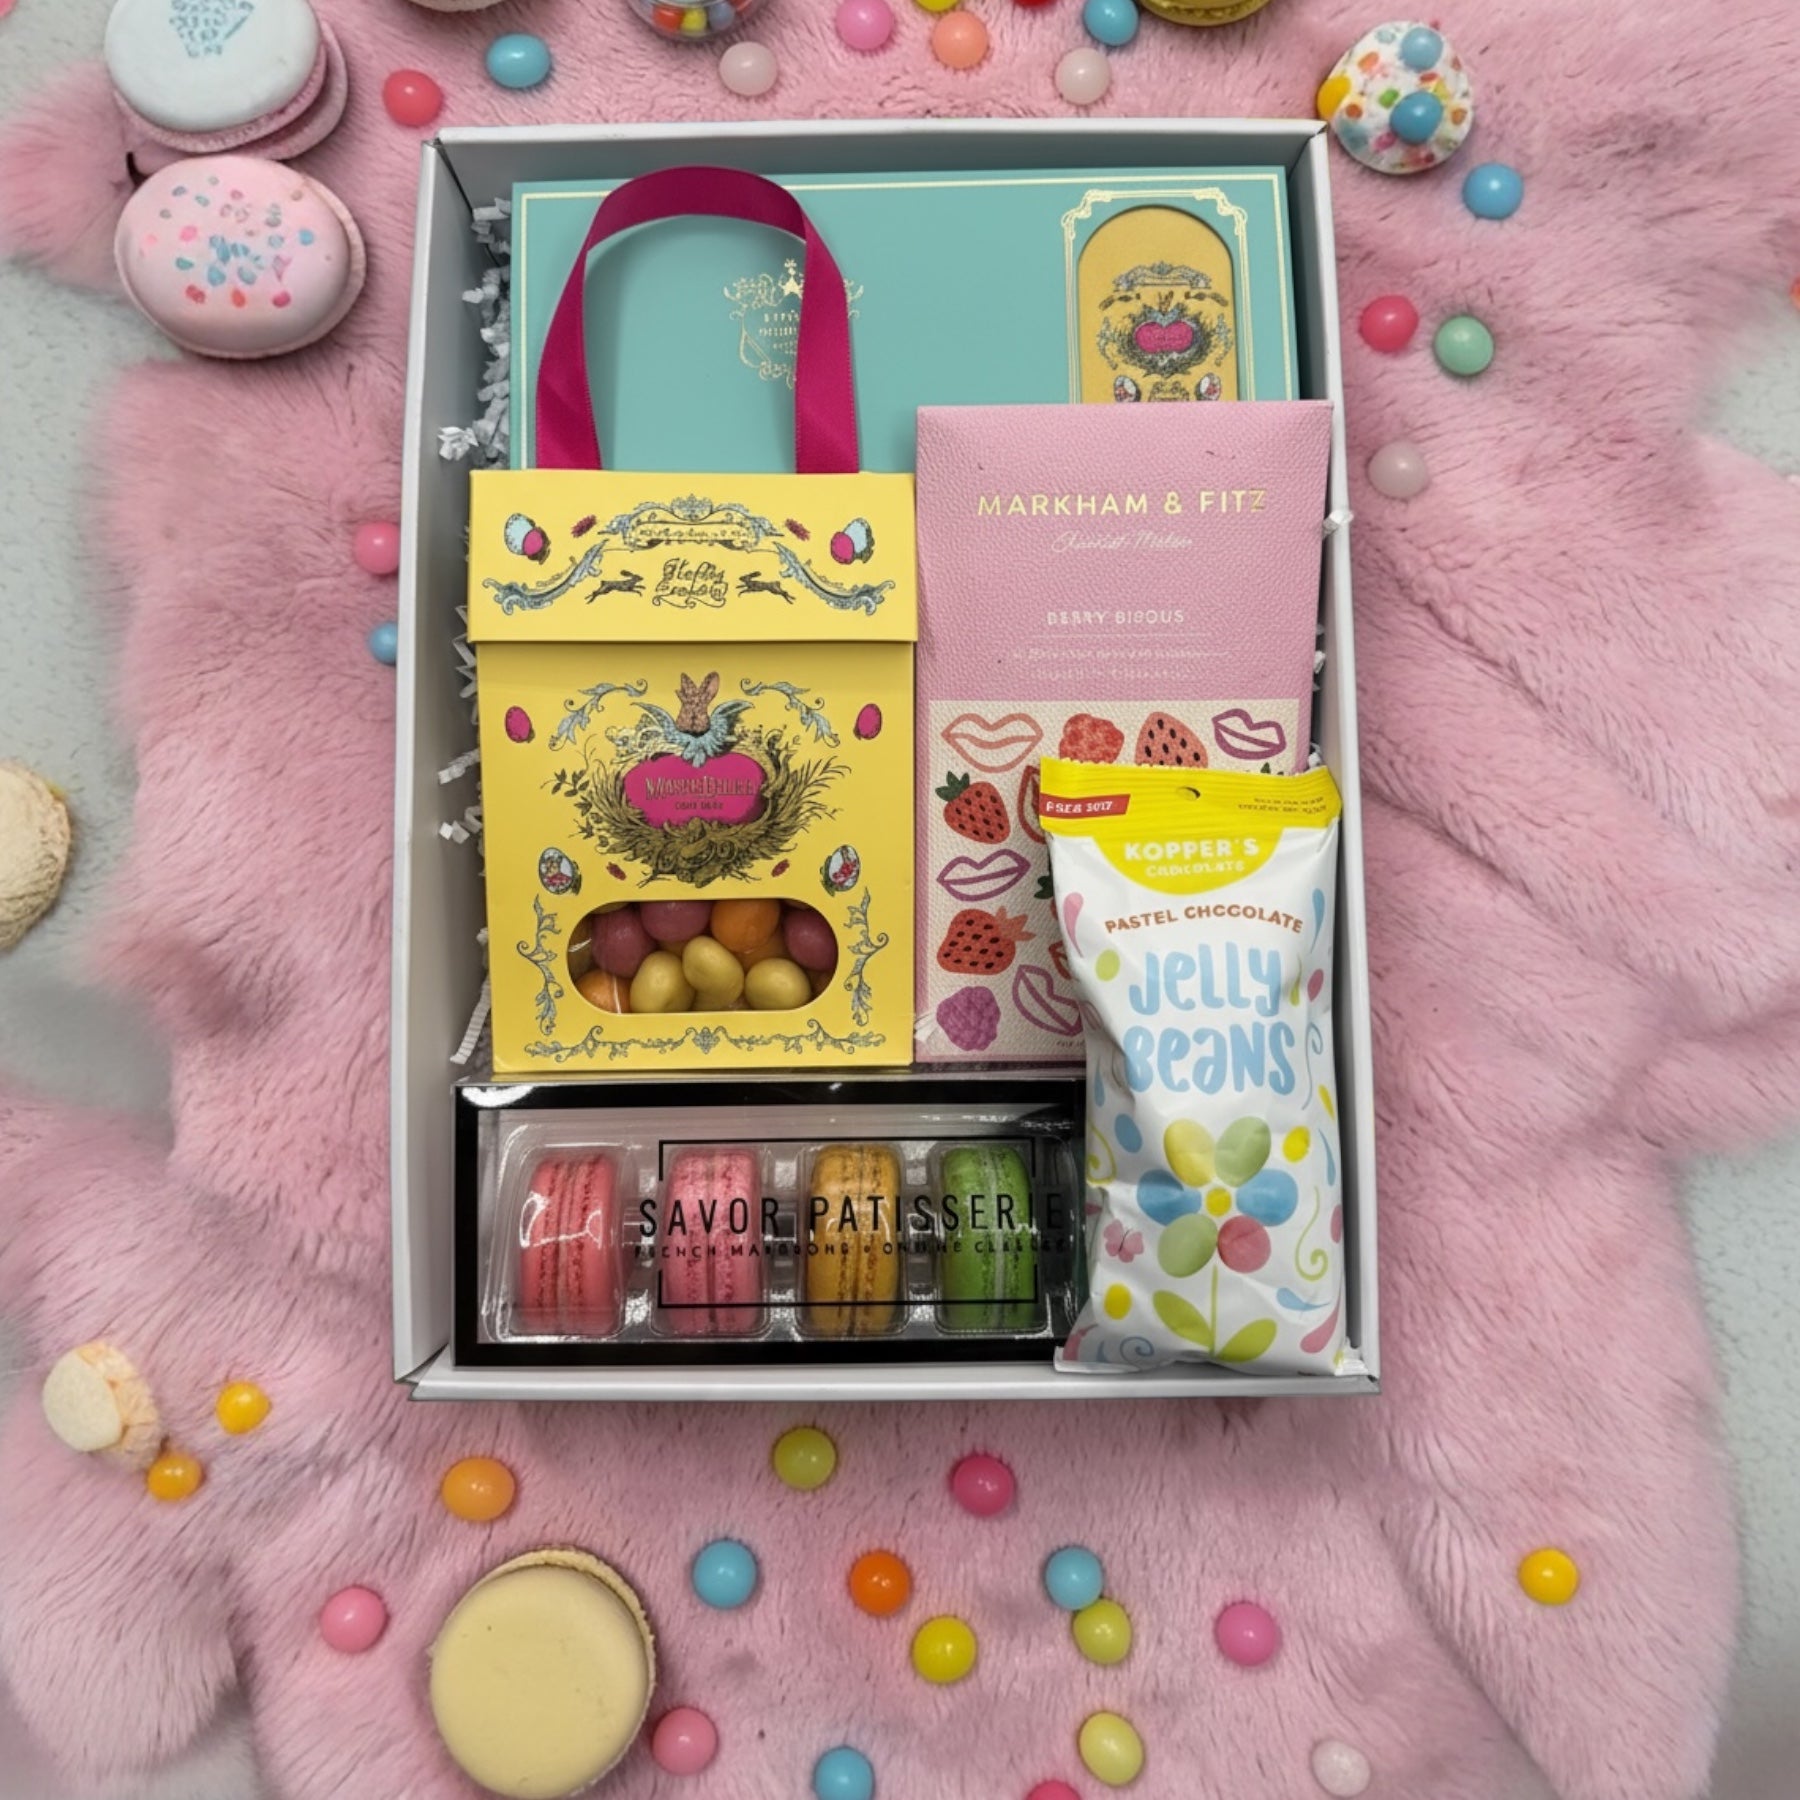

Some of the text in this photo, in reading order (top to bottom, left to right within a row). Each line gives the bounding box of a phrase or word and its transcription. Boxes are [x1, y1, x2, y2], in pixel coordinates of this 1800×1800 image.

[977, 488, 1267, 516] MARKHAM & FITZ
[1124, 838, 1260, 862] KOPPER'S
[1104, 909, 1179, 934] PASTEL
[639, 1193, 1065, 1238] SAVOR PATISSERIE
